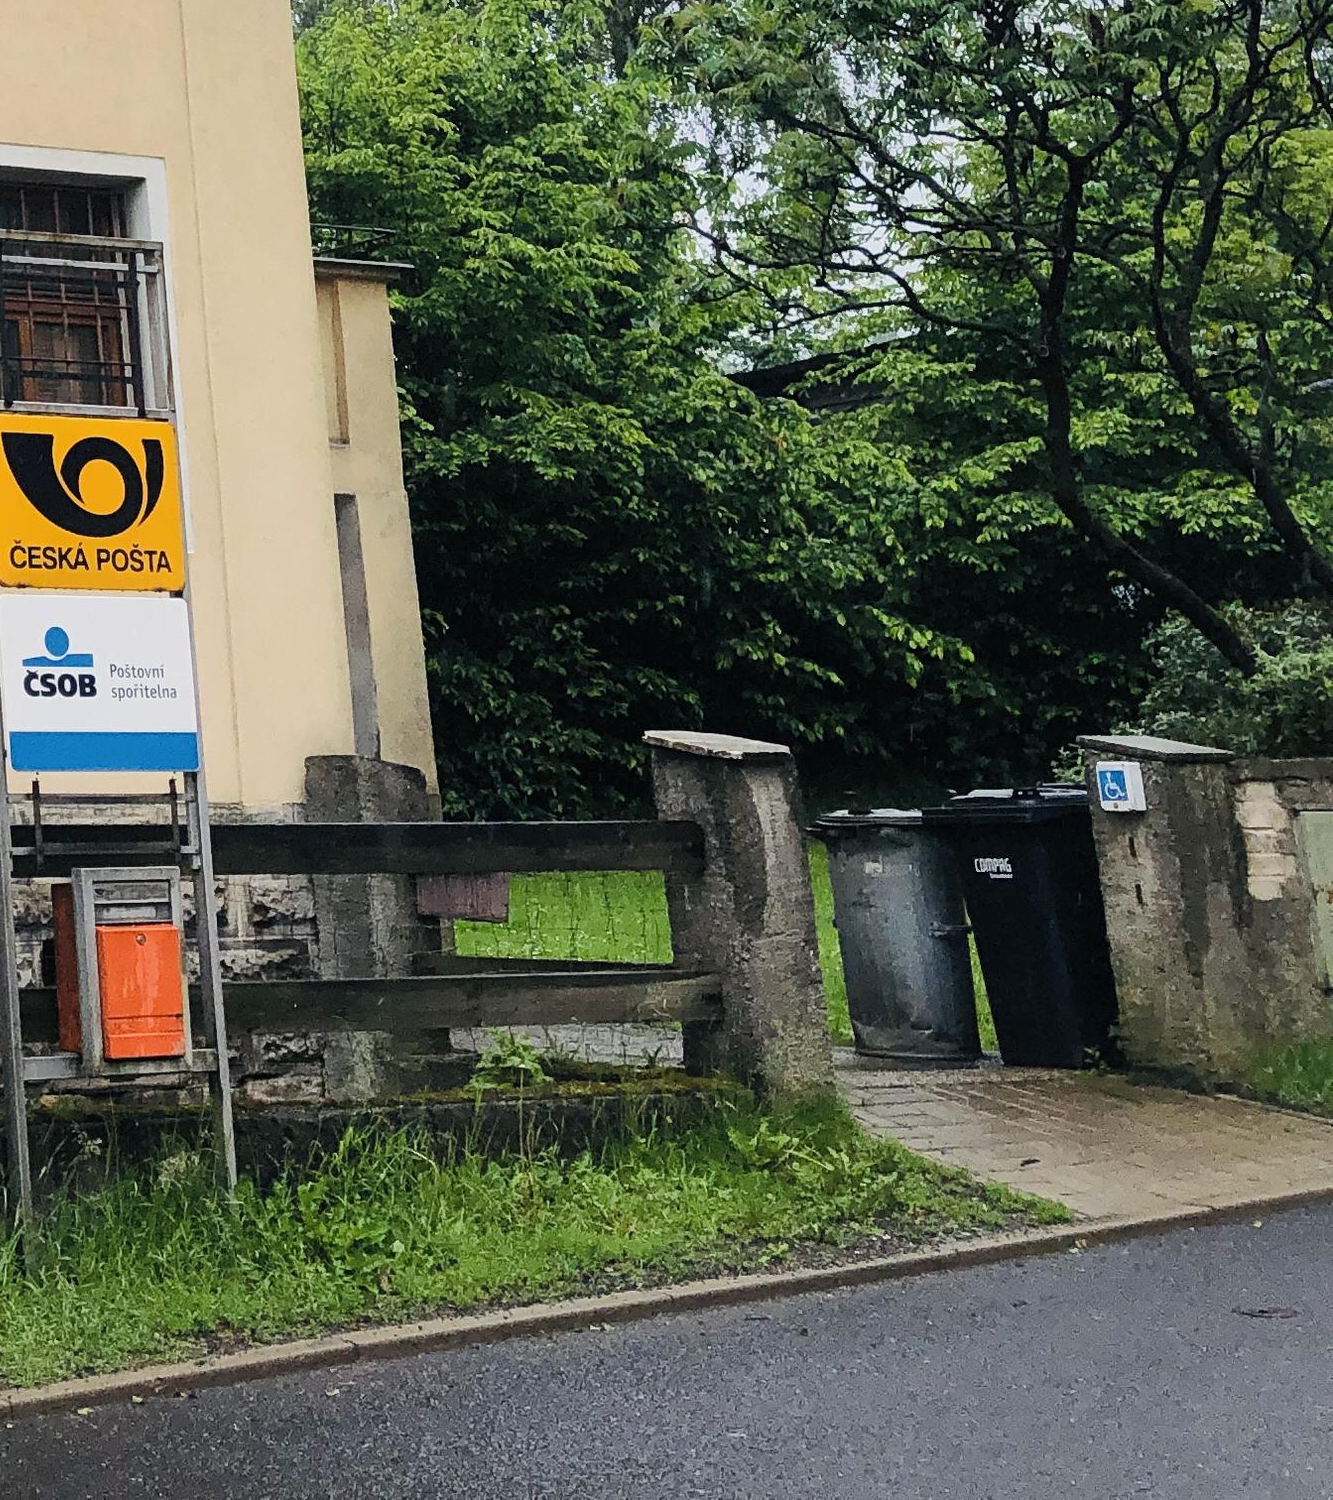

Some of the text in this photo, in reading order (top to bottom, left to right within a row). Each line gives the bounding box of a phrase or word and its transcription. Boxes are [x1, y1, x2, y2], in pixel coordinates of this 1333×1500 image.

[9, 539, 173, 573] ČESKÁ POŠTA
[109, 663, 165, 679] Poštovní
[23, 669, 97, 698] ČSOB
[111, 684, 178, 702] spořitelna
